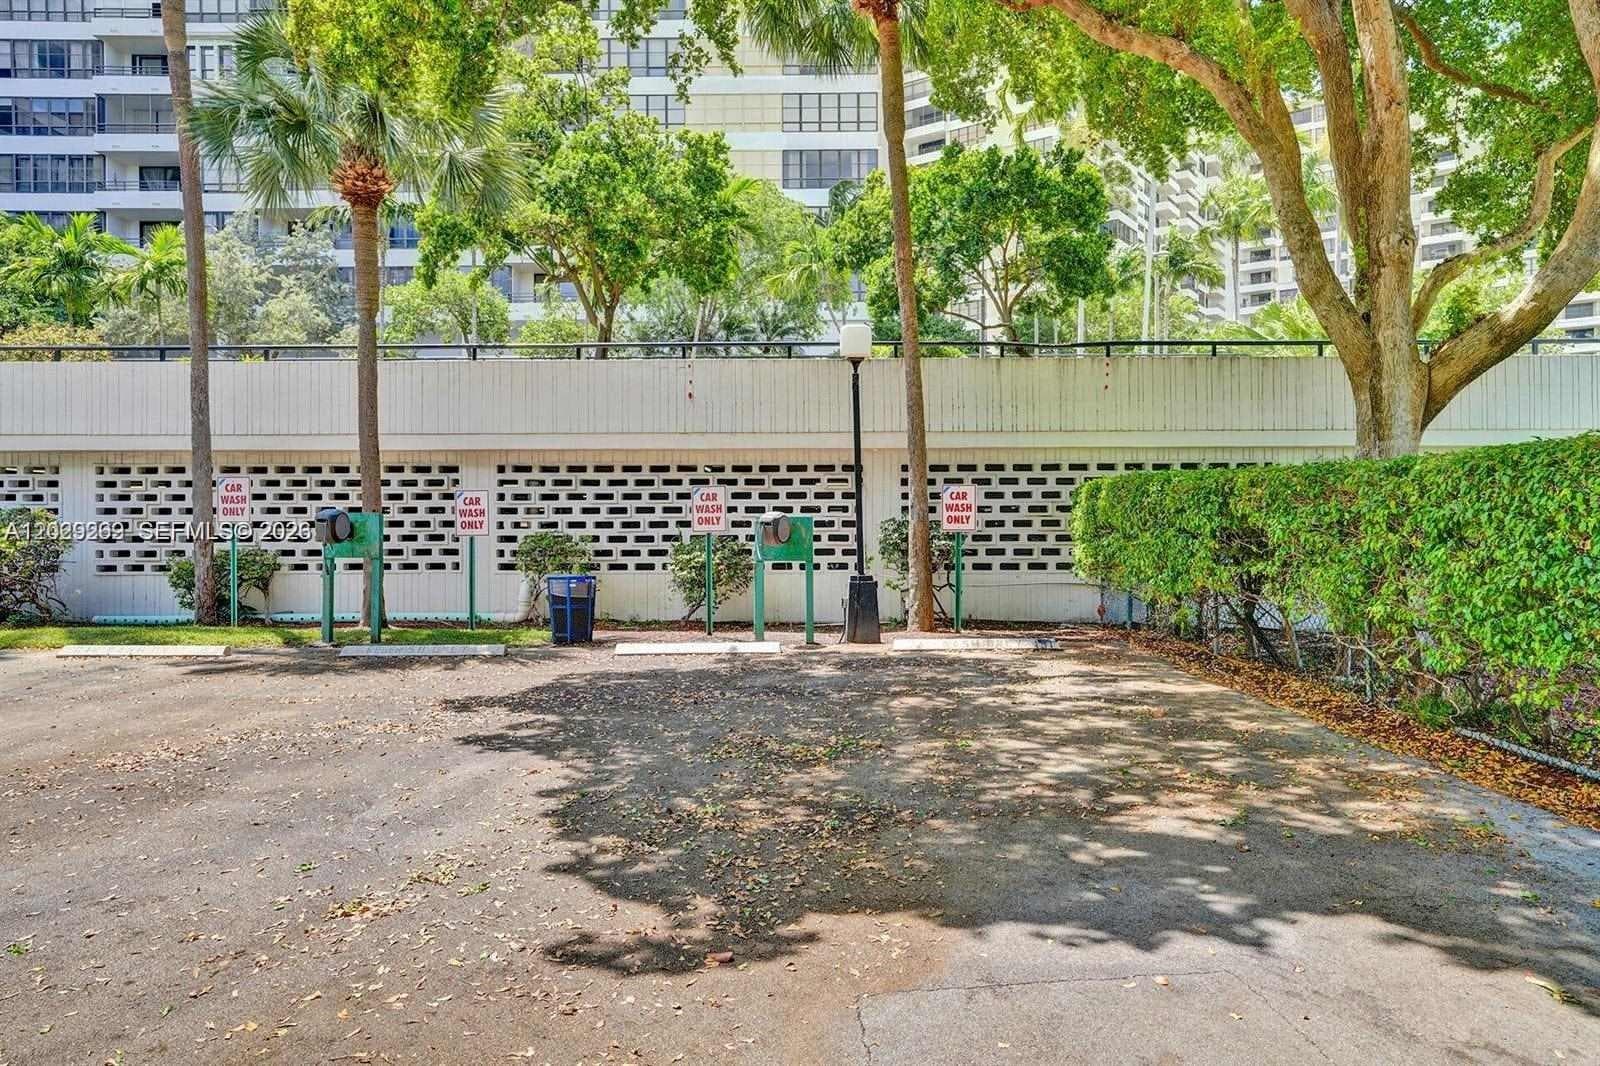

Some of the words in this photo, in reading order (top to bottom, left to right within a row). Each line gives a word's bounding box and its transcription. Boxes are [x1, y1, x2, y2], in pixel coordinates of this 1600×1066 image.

[224, 483, 242, 493] CAR
[220, 495, 247, 505] WASH
[463, 496, 481, 506] CAR
[700, 492, 718, 502] CAR
[949, 491, 968, 501] CAR
[222, 507, 246, 517] ONLY
[458, 508, 486, 518] WASH
[695, 504, 722, 514] WASH
[945, 503, 972, 513] WASH
[460, 520, 484, 530] ONLY
[697, 516, 721, 526] ONLY
[946, 515, 971, 525] ONLY
